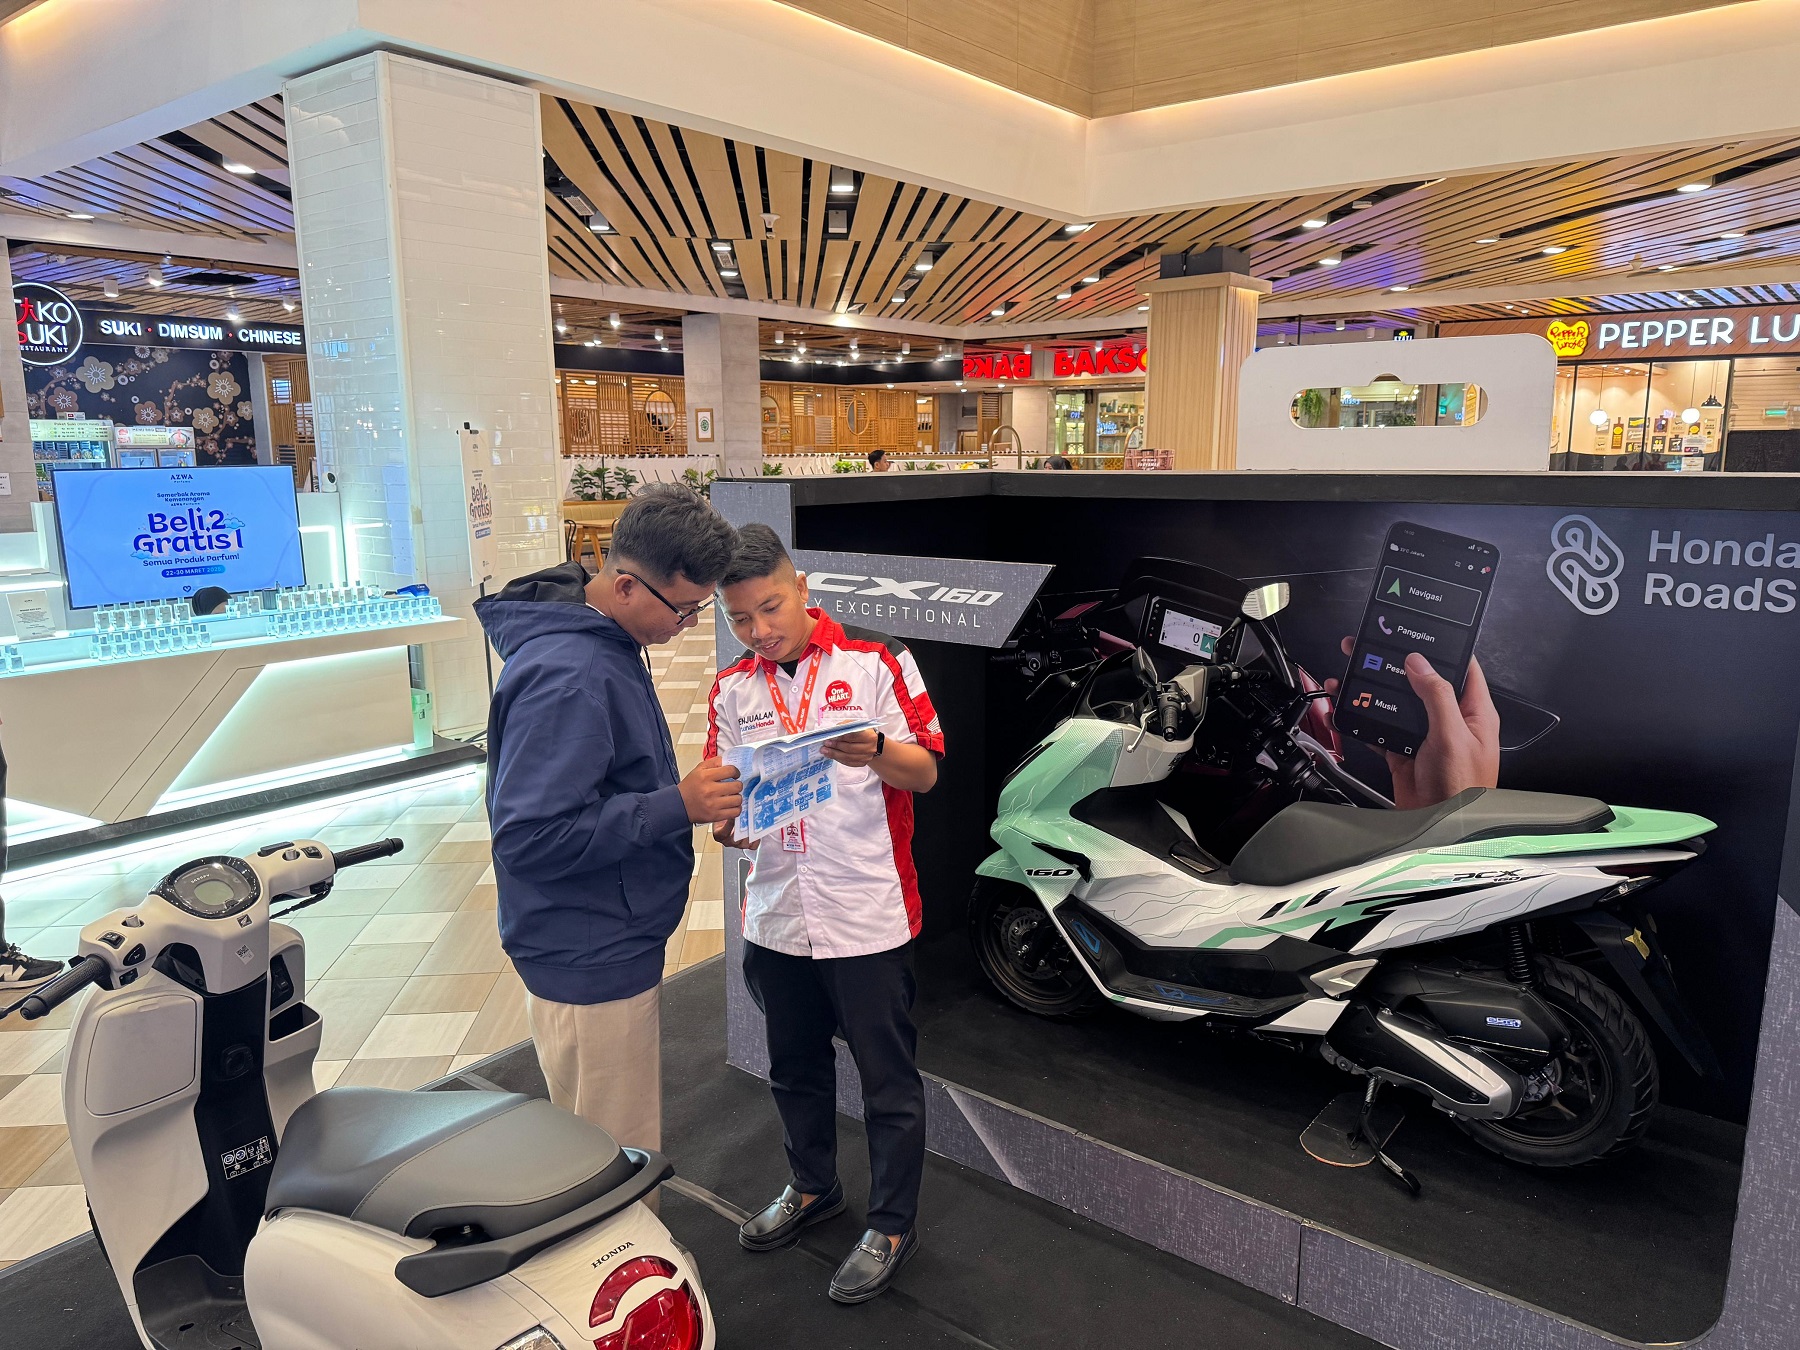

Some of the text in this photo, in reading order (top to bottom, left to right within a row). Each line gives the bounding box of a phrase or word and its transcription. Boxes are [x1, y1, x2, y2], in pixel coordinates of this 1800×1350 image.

[100, 319, 302, 346] SUKI DIMSUM CHINESE
[1599, 313, 1800, 350] PEPPER LU
[148, 507, 226, 533] Beli 2
[133, 527, 232, 554] Gratis
[1648, 529, 1800, 569] Honda
[143, 559, 173, 567] Semua
[174, 556, 205, 565] Produk
[184, 567, 205, 575] MARET
[1408, 586, 1442, 602] Navigasi
[1644, 572, 1797, 614] RoadS
[836, 600, 981, 628] EXCEPTIONAL
[1192, 632, 1200, 644] 0
[1397, 625, 1436, 643] Panggilan
[1385, 663, 1407, 676] Pesa
[1374, 699, 1398, 713] Musik
[1025, 868, 1076, 877] 160
[1452, 868, 1524, 882] PCX
[591, 1241, 635, 1269] HONDA
